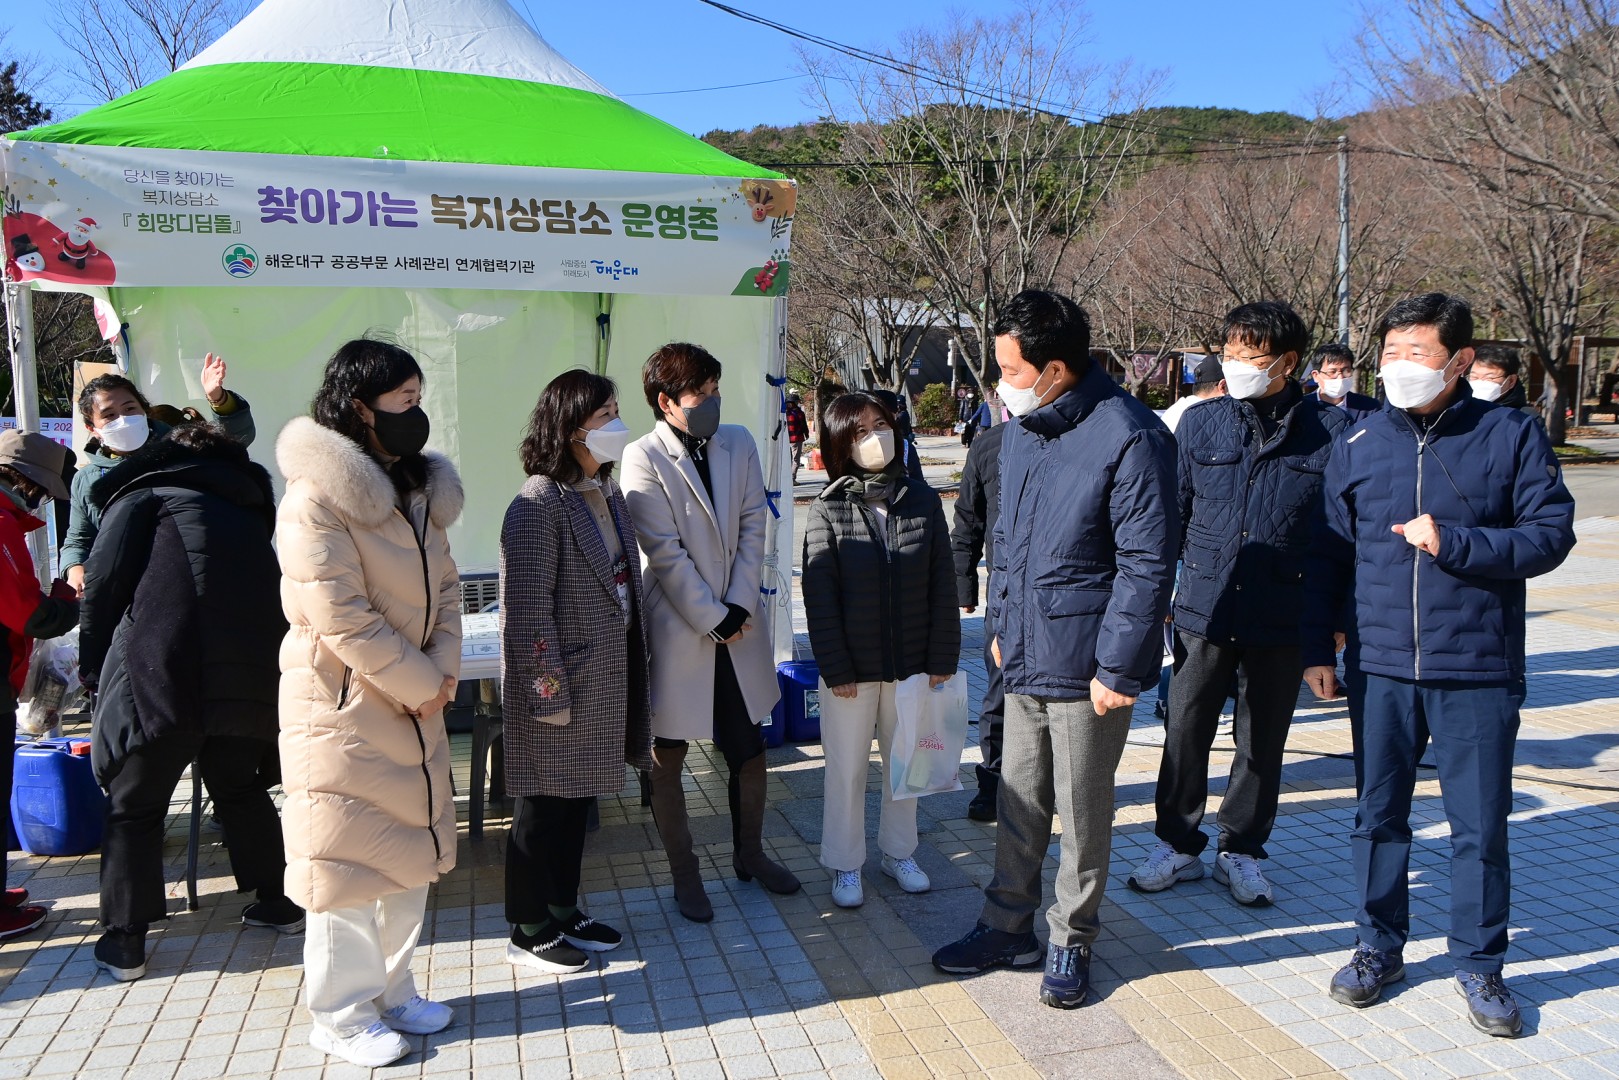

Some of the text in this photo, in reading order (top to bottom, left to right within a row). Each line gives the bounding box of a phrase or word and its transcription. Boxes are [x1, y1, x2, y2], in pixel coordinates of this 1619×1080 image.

[124, 169, 235, 188] 당신을 찾아가는
[142, 189, 220, 207] 복지상담소
[257, 185, 720, 242] 찾아가는 복지상담소 운영존
[264, 253, 536, 275] 해운대구 공공부문 사례관리 연계협력기관
[563, 269, 590, 279] 미래도시
[590, 259, 639, 281] 해운대
